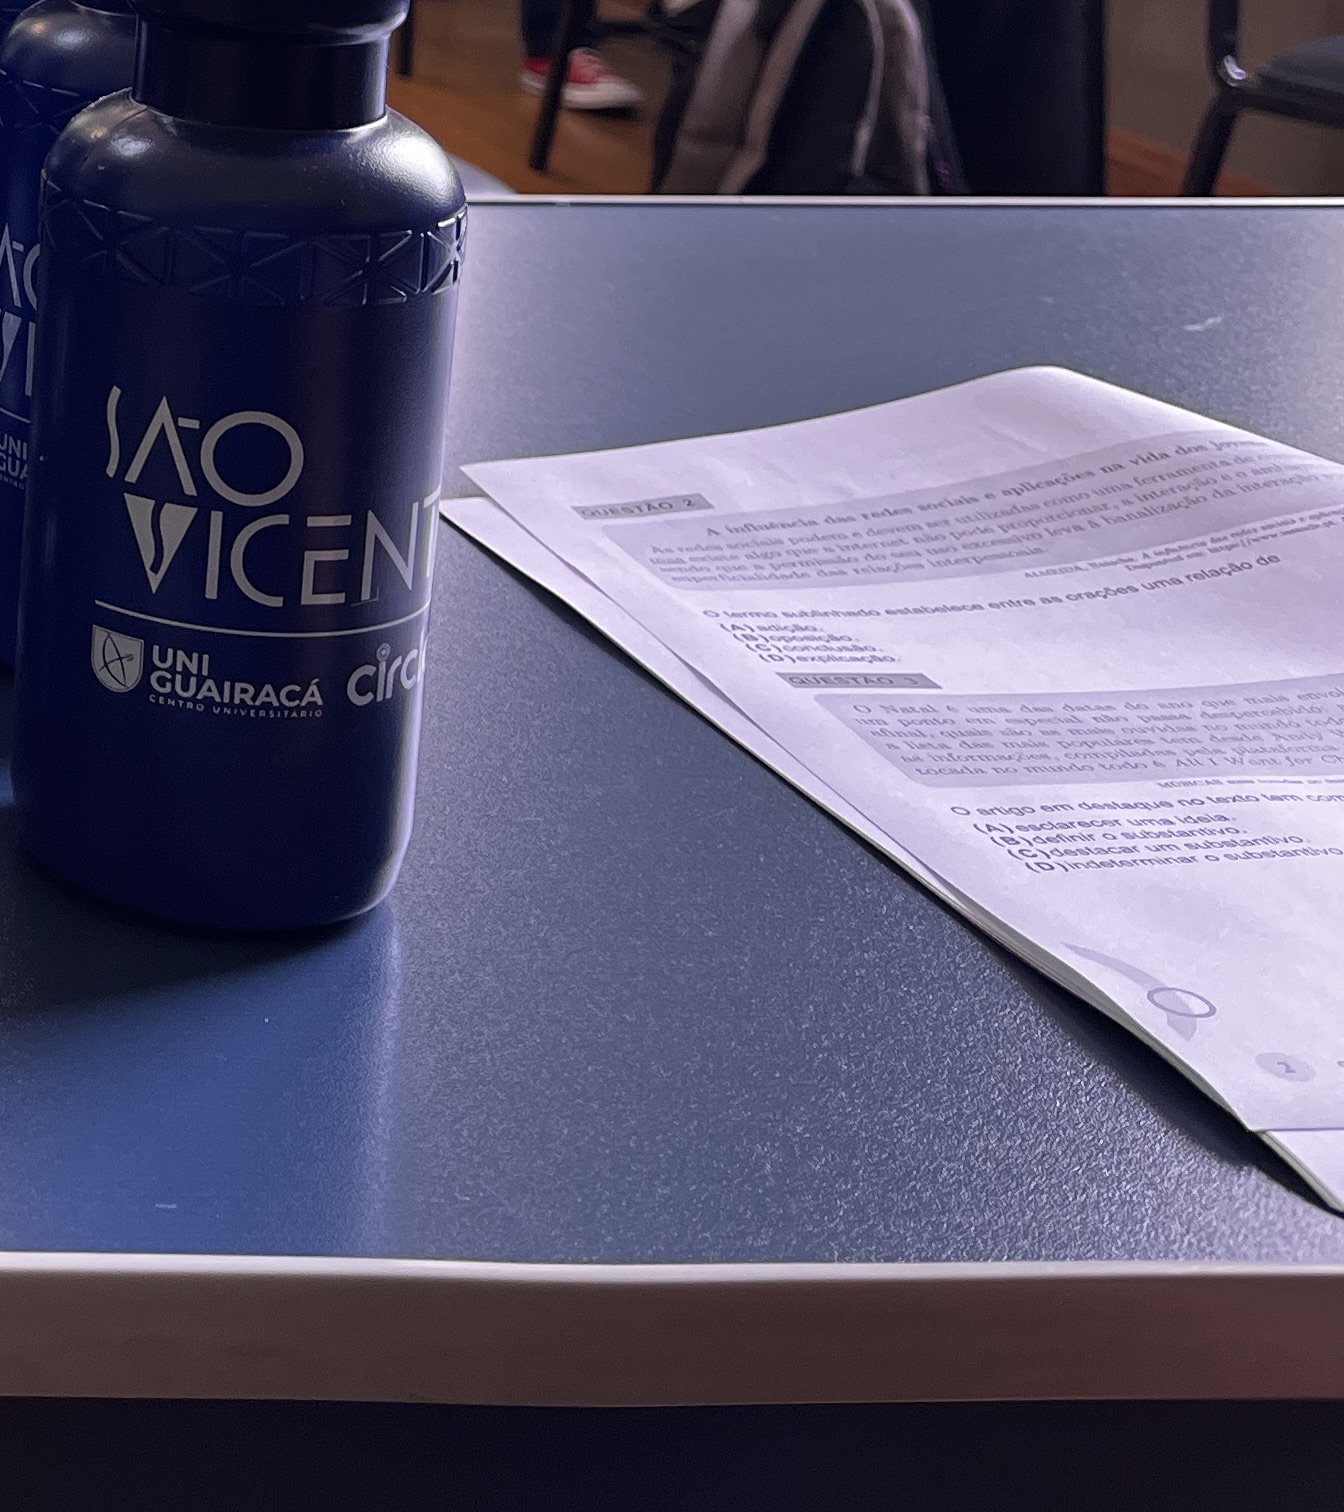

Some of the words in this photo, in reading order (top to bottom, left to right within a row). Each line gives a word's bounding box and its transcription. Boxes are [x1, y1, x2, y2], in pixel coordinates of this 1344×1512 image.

[1001, 470, 1097, 497] aplicações
[1100, 463, 1127, 474] na
[1128, 450, 1172, 467] vida
[1043, 491, 1091, 508] como
[1132, 458, 1233, 488] ferramenta
[581, 501, 673, 517] QUESTÃO
[682, 498, 697, 507] 2
[1099, 494, 1209, 526] banalização
[1212, 488, 1238, 499] da
[1240, 469, 1321, 493] interação
[913, 531, 947, 544] não
[1133, 476, 1218, 503] interação
[987, 598, 1037, 610] entre
[1065, 585, 1141, 602] orações
[1141, 578, 1184, 591] uma
[1184, 561, 1254, 583] relação
[1255, 554, 1282, 567] de
[151, 644, 210, 676] UNI
[149, 669, 324, 707] GUAIRACÁ
[788, 675, 895, 686] QUESTÃO
[148, 693, 206, 713] CENTRO
[852, 704, 872, 714] O
[1243, 693, 1291, 705] mais
[897, 717, 956, 727] ponto
[1233, 719, 1301, 731] mundo
[915, 764, 988, 775] tocada
[992, 766, 1018, 774] no
[1023, 763, 1095, 774] mundo
[1176, 757, 1206, 767] All
[1284, 755, 1313, 767] for
[950, 805, 971, 816] O
[976, 805, 1036, 816] artigo
[1040, 803, 1076, 812] em
[1078, 800, 1174, 811] destaque
[1177, 798, 1206, 807] no
[1206, 794, 1261, 804] texto
[1126, 817, 1176, 827] uma
[1120, 826, 1248, 840] substantivo.
[1144, 843, 1182, 853] um
